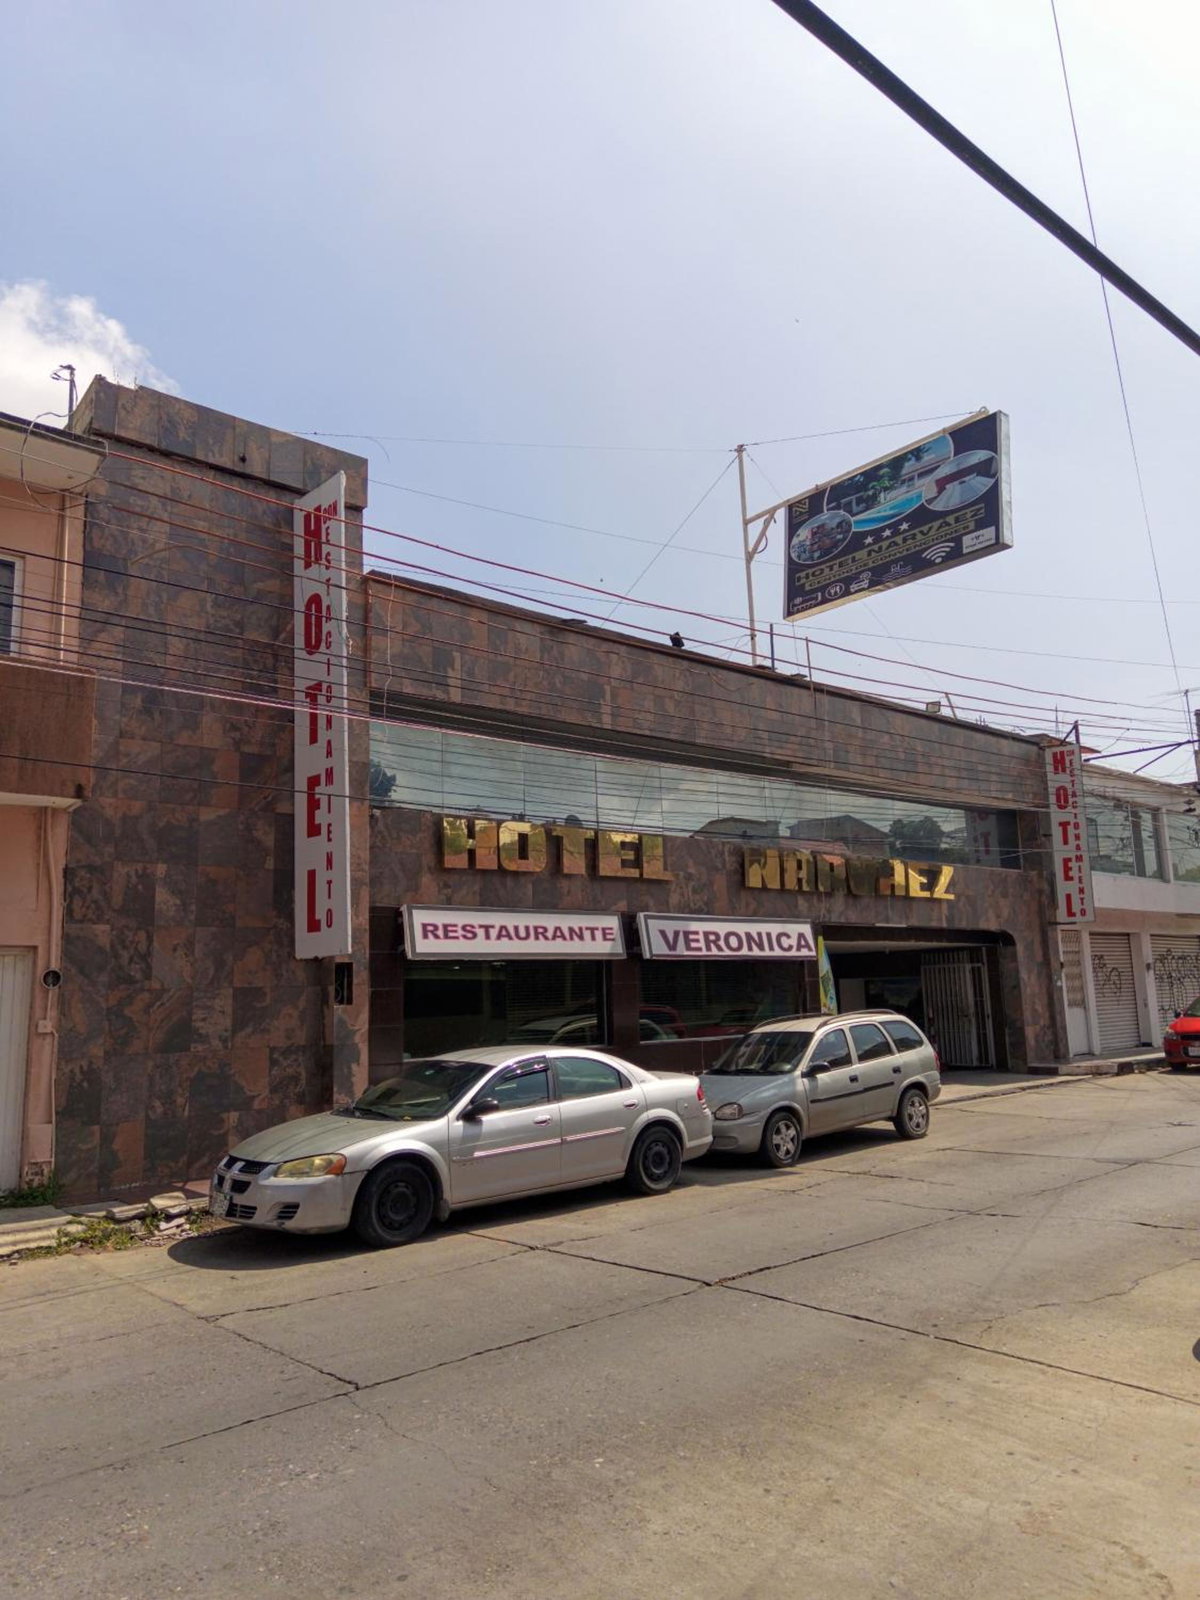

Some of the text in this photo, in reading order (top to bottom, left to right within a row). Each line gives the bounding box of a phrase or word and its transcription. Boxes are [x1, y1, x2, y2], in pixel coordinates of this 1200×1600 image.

[322, 499, 338, 525] CON
[796, 555, 861, 584] HOTEL
[867, 506, 984, 556] NARVAEZ
[871, 523, 970, 565] CONVENCIONES
[303, 504, 323, 933] HOTEL
[324, 525, 334, 929] ESTACIONAMIENTO
[441, 816, 956, 901] HOTEL NARVAEZ
[1052, 750, 1076, 917] HOTEL
[1069, 760, 1086, 917] ESTACIONAMIENTO
[420, 921, 616, 943] RESTAURANTE
[658, 928, 816, 954] VERONICA
